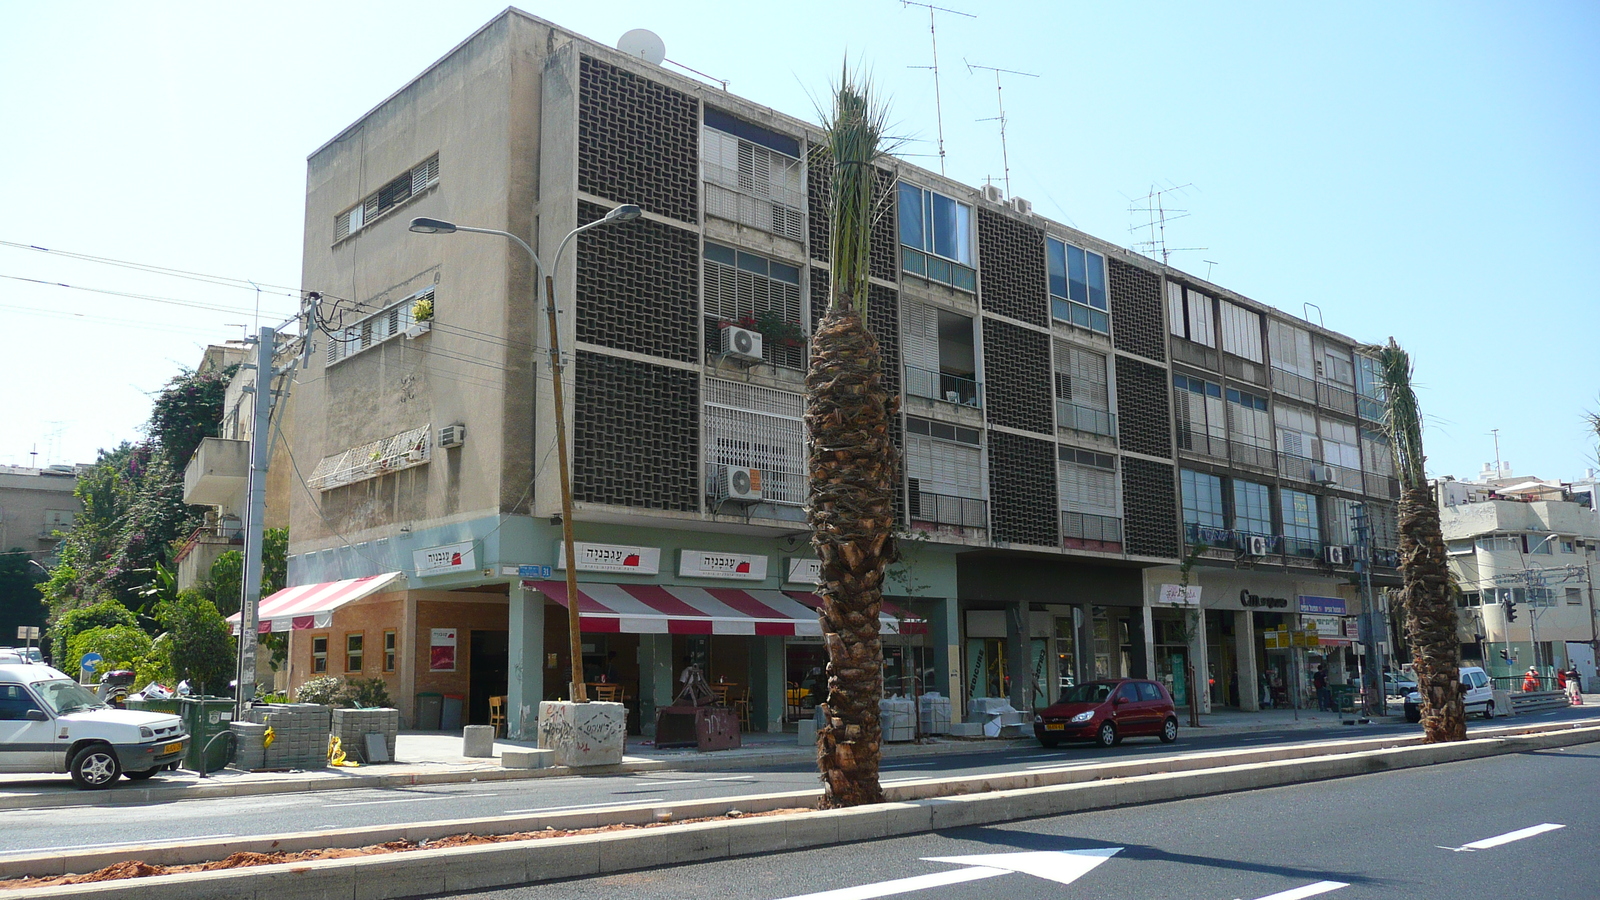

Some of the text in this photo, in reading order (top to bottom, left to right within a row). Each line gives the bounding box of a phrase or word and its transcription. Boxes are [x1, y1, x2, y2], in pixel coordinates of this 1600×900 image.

[587, 549, 622, 562] עגבניה
[704, 555, 735, 569] עגבניה
[543, 567, 549, 576] 31
[970, 649, 984, 697] PEDICURE
